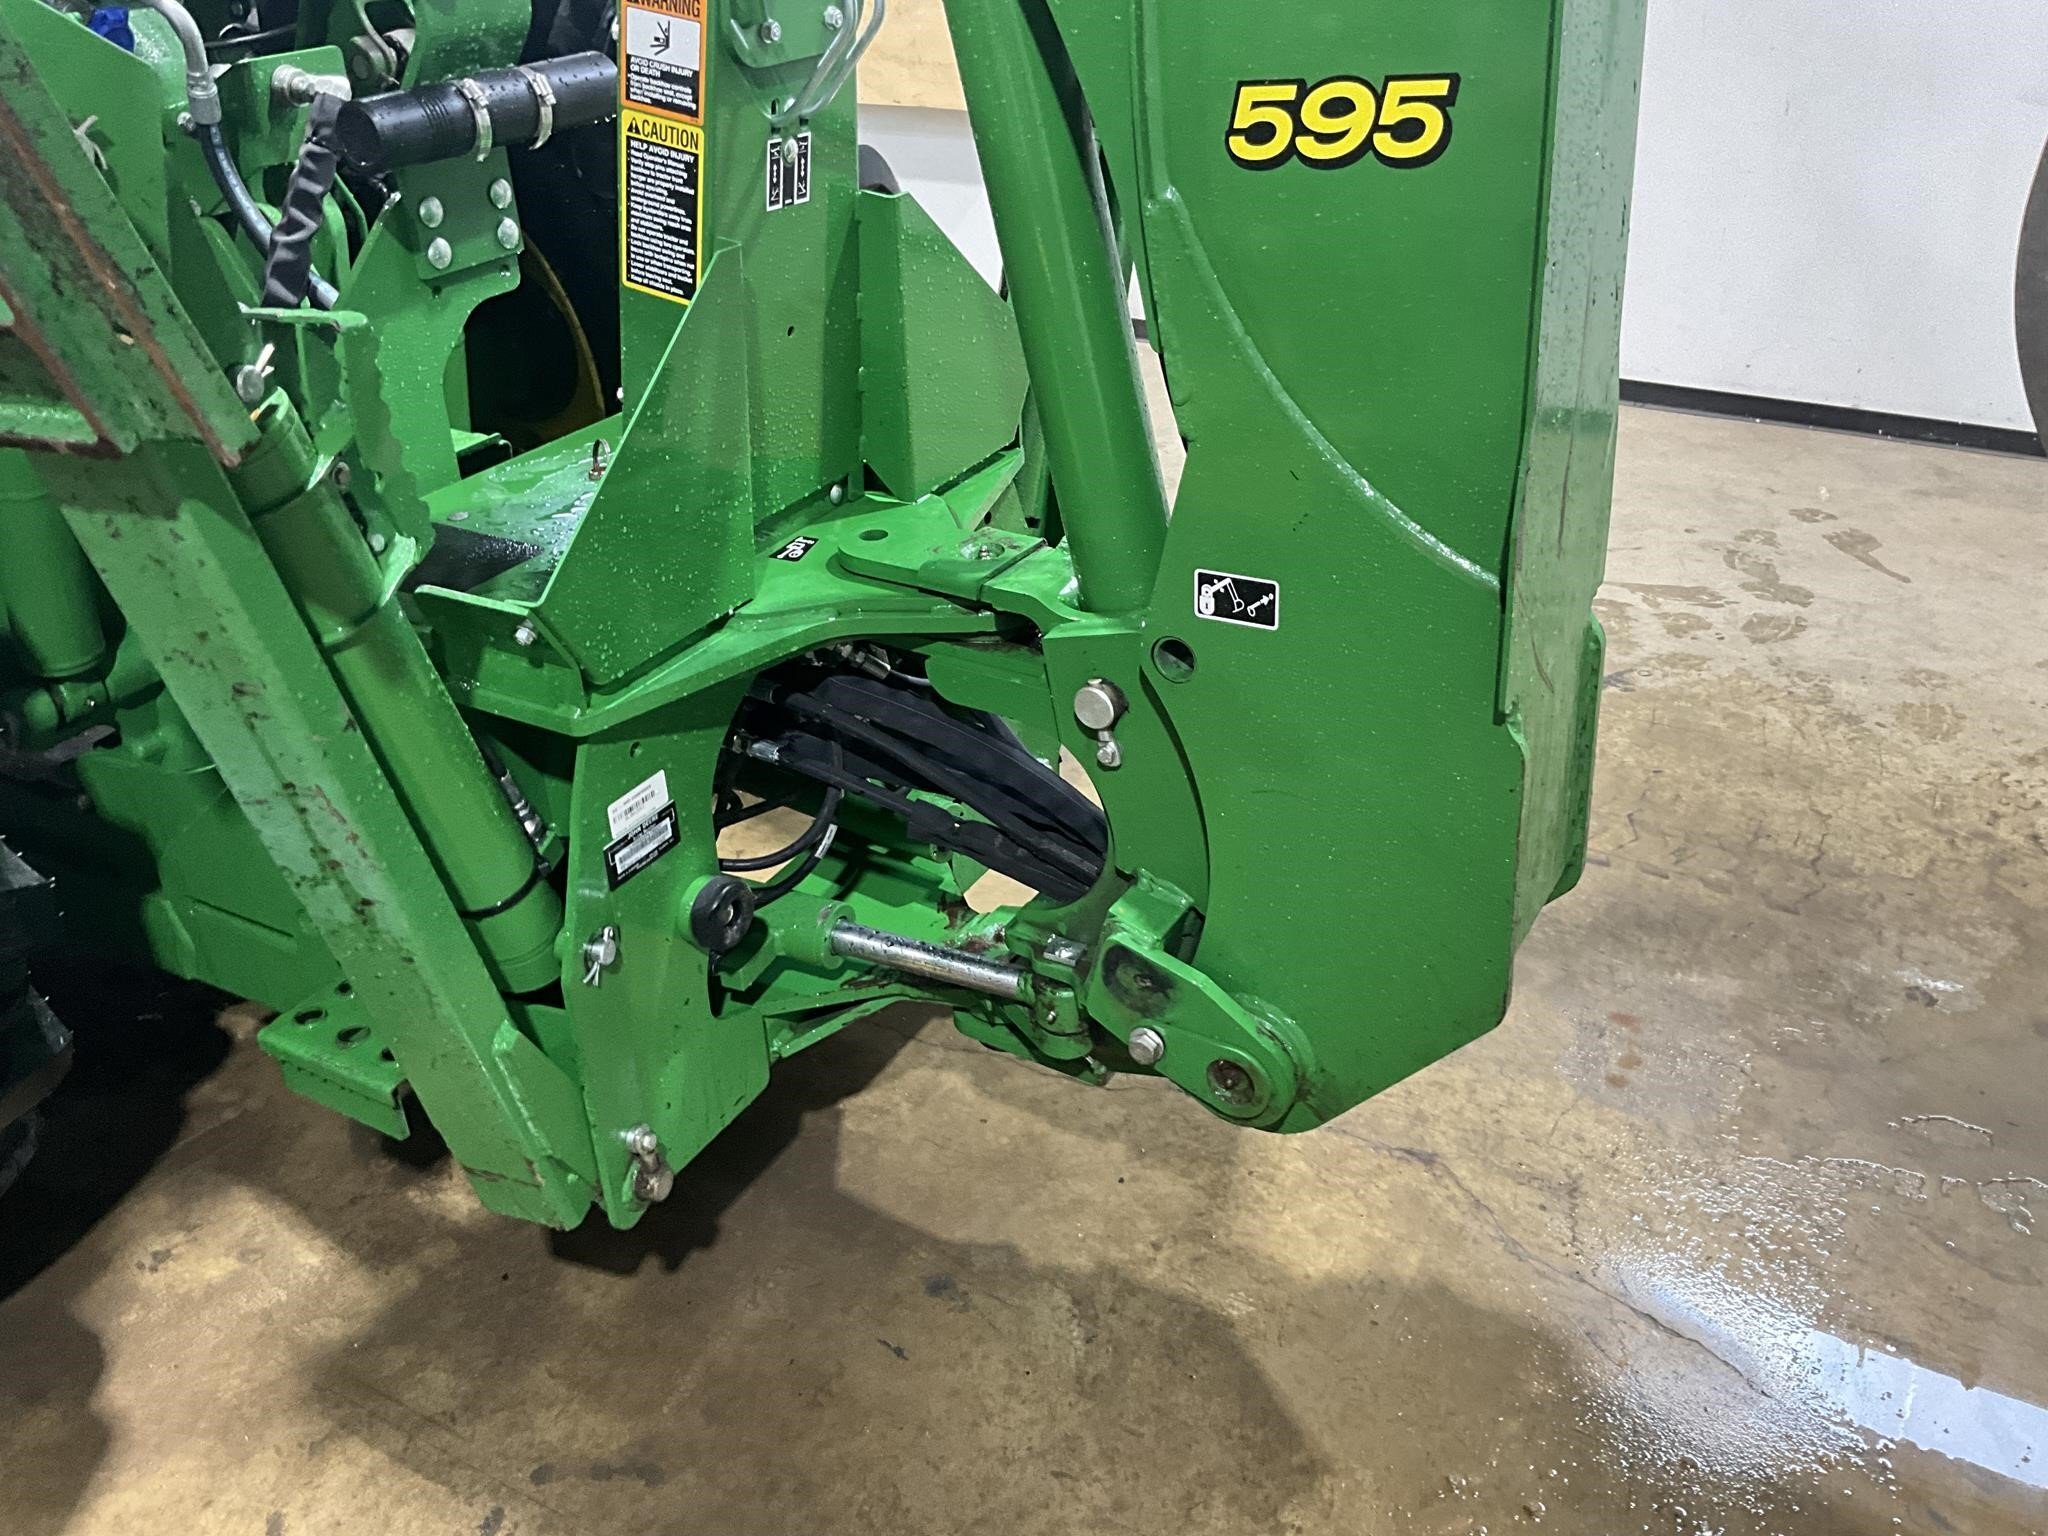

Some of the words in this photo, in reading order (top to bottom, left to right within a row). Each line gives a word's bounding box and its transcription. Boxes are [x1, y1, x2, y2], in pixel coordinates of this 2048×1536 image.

[641, 119, 699, 151] CAUTION
[1227, 74, 1459, 170] 595
[630, 140, 648, 151] HELP
[648, 144, 669, 156] AVOID
[670, 150, 694, 164] INJURY
